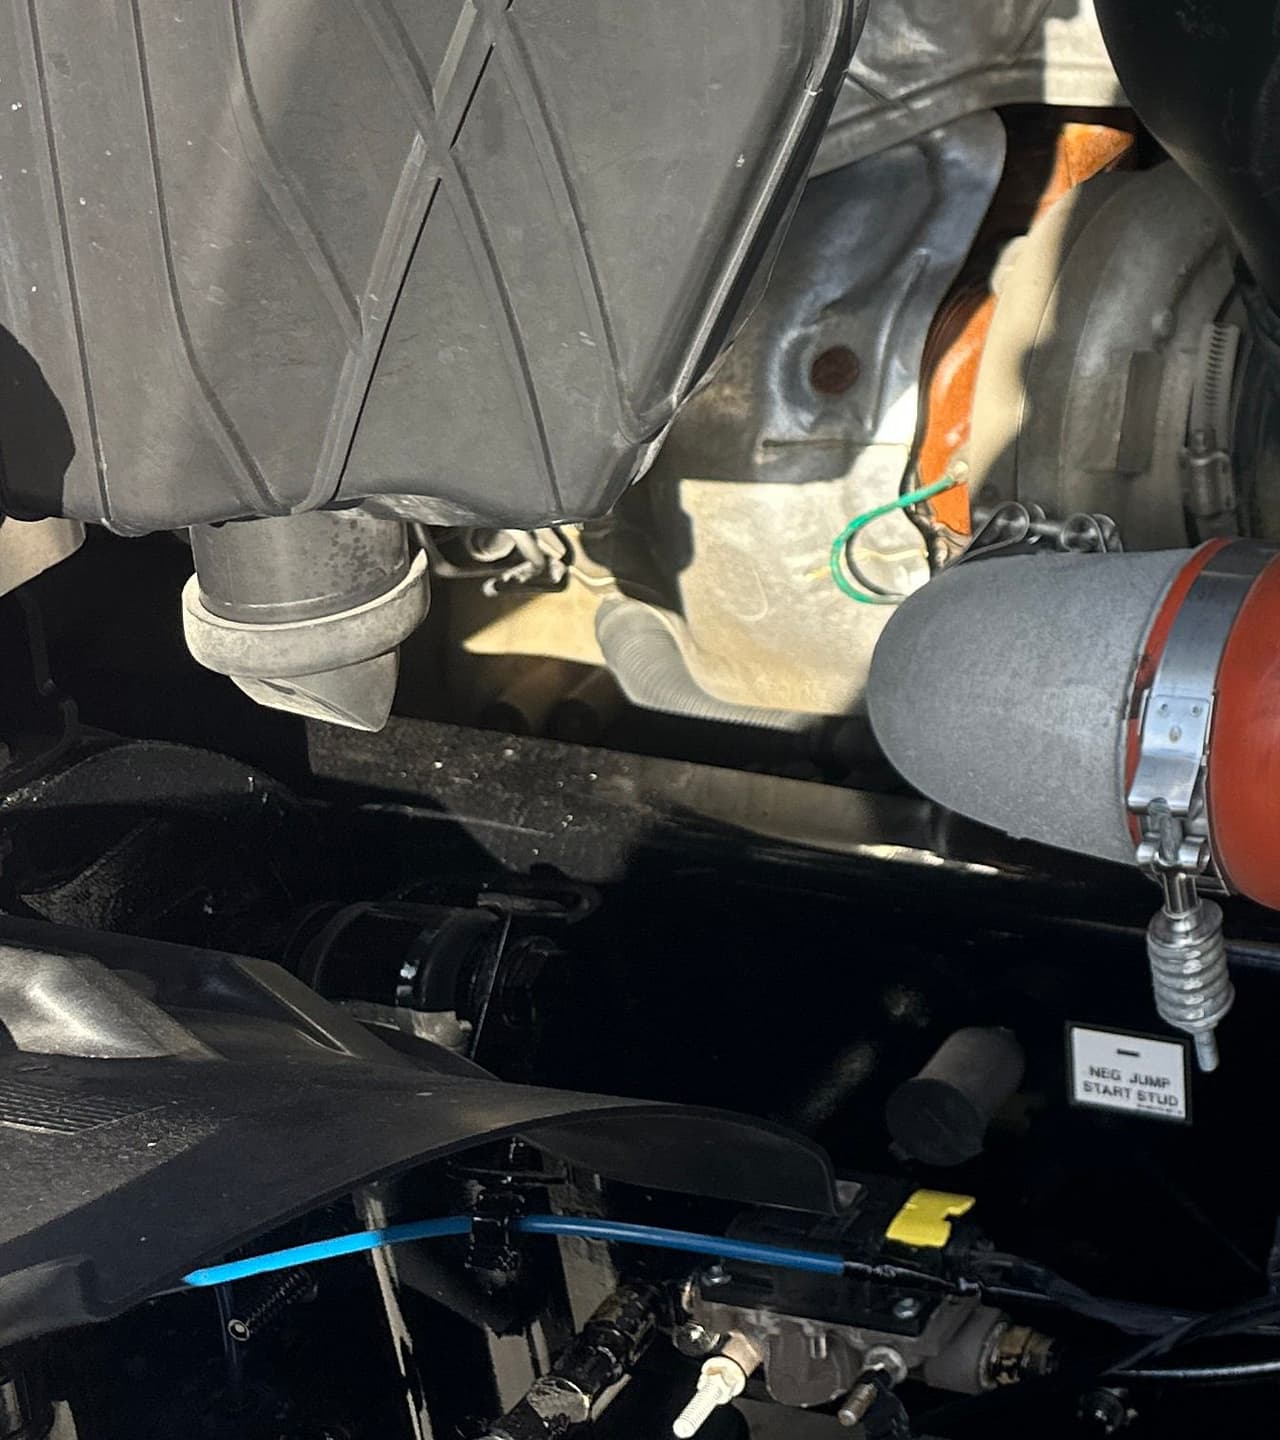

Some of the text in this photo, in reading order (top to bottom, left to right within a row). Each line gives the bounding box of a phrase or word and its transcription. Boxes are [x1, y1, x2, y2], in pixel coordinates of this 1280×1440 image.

[1089, 1066, 1172, 1089] NEG JUMP
[1083, 1081, 1179, 1107] START STUD
